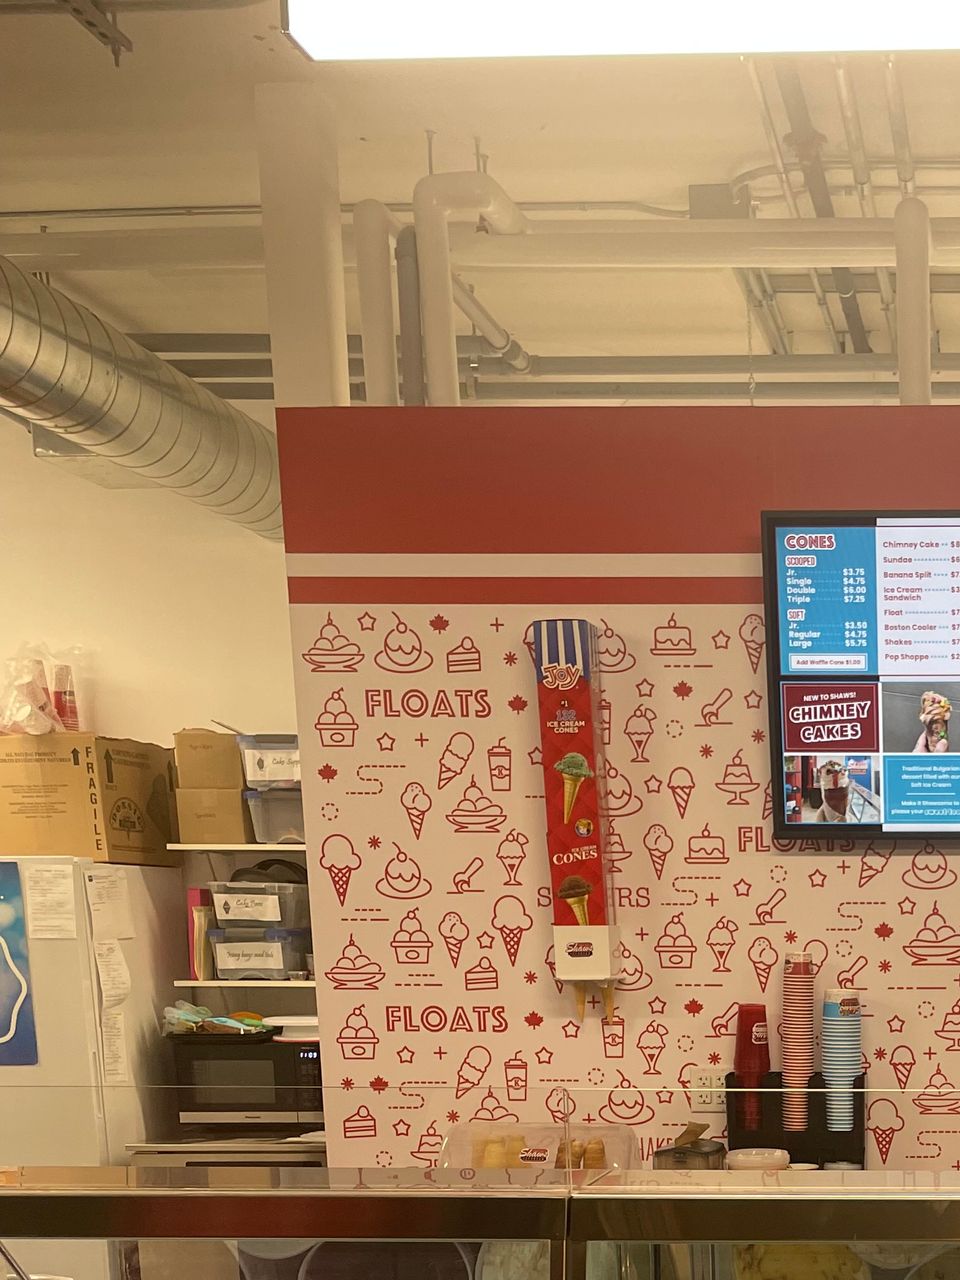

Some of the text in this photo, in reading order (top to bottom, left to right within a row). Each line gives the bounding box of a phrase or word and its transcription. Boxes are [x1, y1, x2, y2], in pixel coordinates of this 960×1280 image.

[785, 534, 836, 550] CONES
[883, 541, 918, 550] Chimney
[842, 568, 864, 576] $3.75
[915, 572, 932, 580] Split
[786, 577, 866, 586] Single $4.75
[786, 586, 816, 594] Double
[787, 596, 810, 604] Triple
[788, 610, 804, 620] SOFT
[788, 630, 868, 640] Regular $4.75
[789, 640, 812, 649] Large
[884, 654, 899, 662] Pop
[900, 654, 929, 662] Shoppe
[803, 694, 819, 702] NEW
[830, 692, 856, 700] SHAWS!
[365, 690, 491, 718] FLOATS
[790, 702, 870, 722] CHIMNEY
[546, 720, 558, 728] ICE
[801, 724, 860, 741] CAKES
[85, 746, 103, 851] FRAGILE
[552, 850, 598, 866] CONES
[386, 1006, 508, 1032] FLOATS
